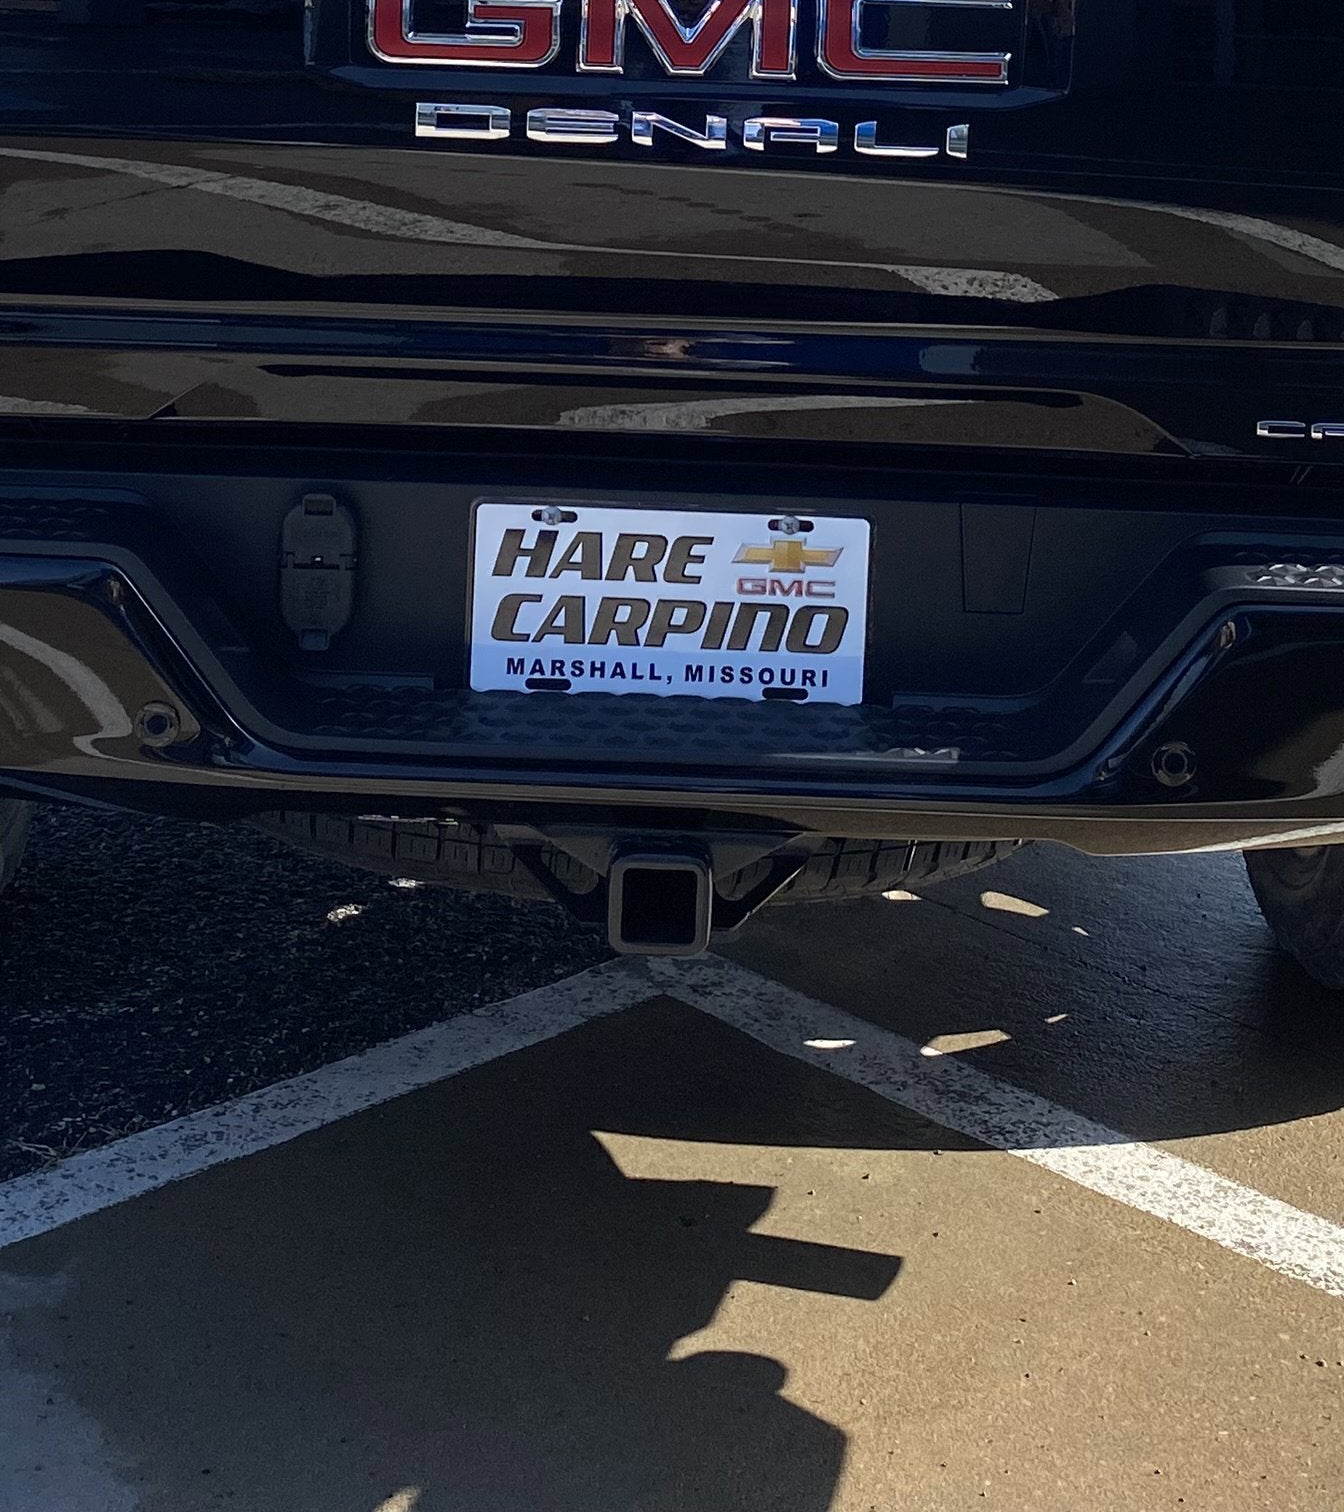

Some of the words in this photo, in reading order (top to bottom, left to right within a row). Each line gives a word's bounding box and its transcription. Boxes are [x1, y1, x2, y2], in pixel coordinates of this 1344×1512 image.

[415, 101, 970, 159] DENALI
[492, 528, 714, 585] HARE
[736, 577, 836, 599] GMC
[490, 593, 849, 654] CARPINO
[506, 657, 672, 685] MARSHALL,
[684, 664, 829, 688] MISSOURI
